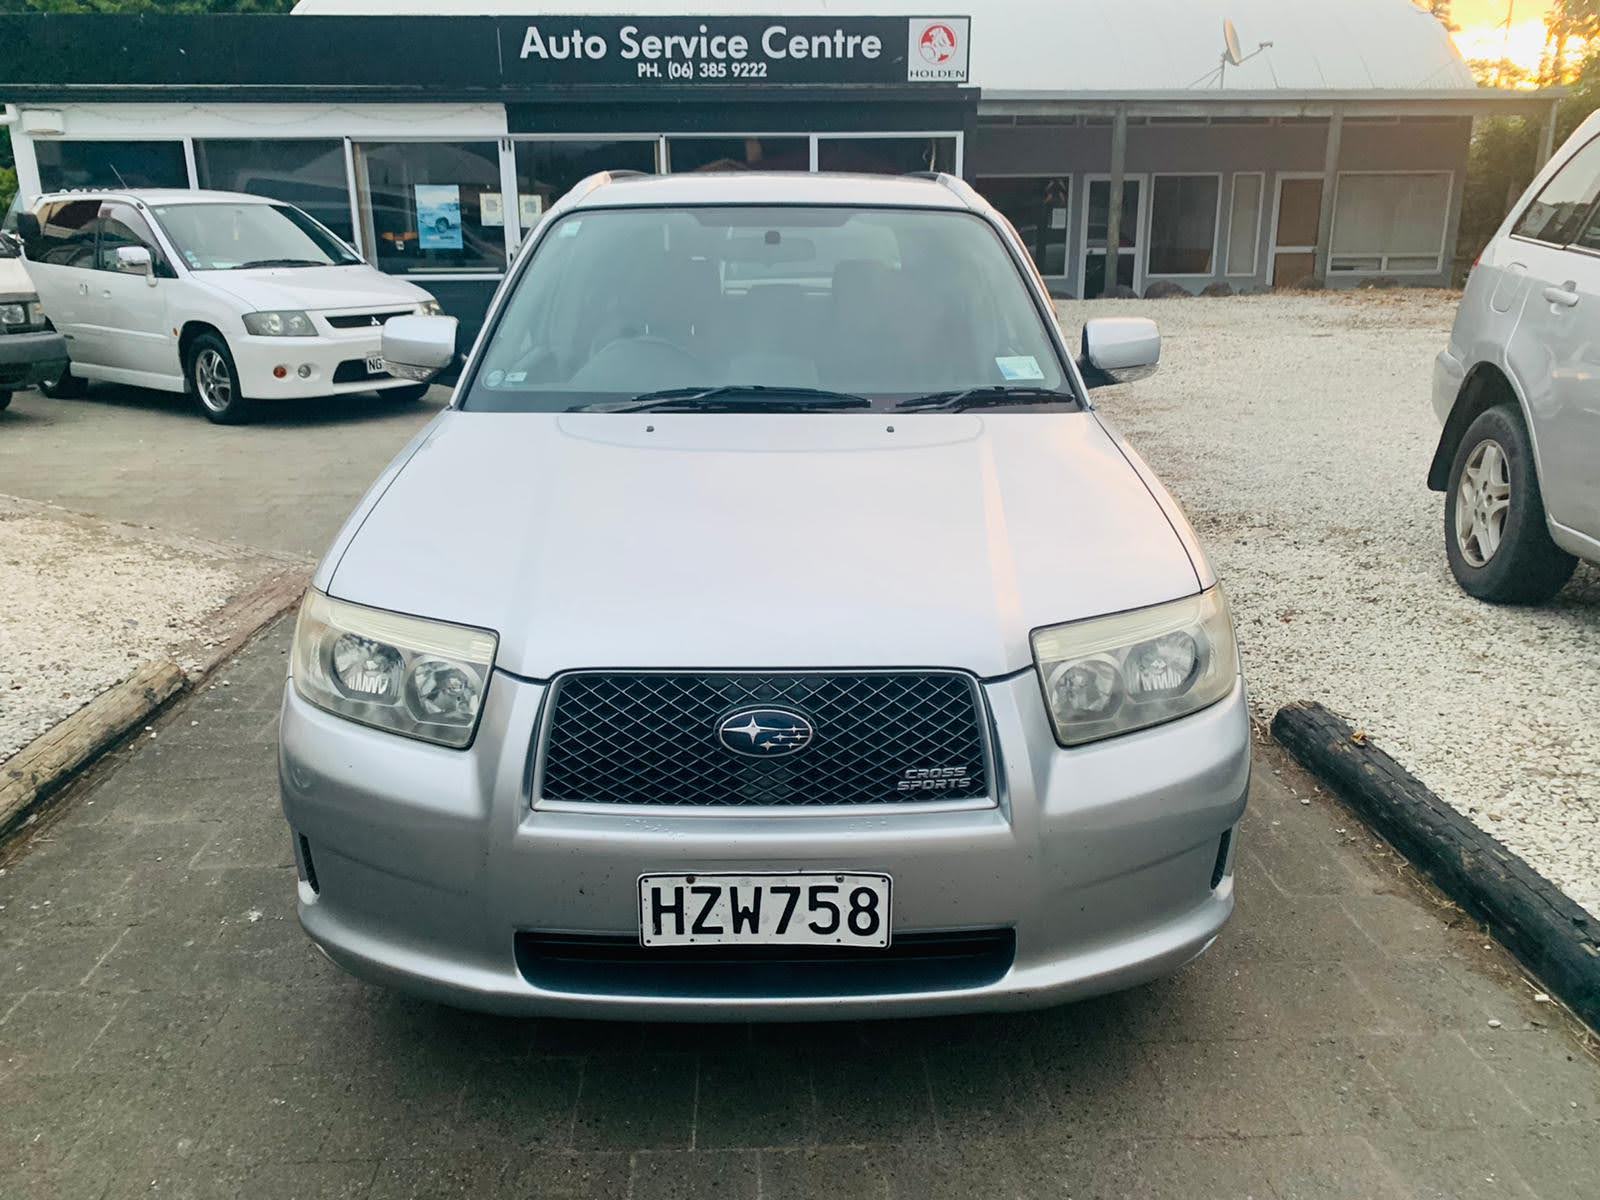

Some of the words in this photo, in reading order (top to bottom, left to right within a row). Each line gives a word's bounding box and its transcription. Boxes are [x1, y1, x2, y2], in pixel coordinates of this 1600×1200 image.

[519, 26, 607, 60] Auto
[620, 26, 749, 60] Service
[761, 26, 882, 60] Centre
[637, 63, 662, 78] PH.
[667, 62, 694, 80] (06)
[699, 63, 728, 78] 385
[731, 63, 768, 78] 9222
[909, 69, 965, 79] HOLDEN
[368, 358, 383, 371] NG
[904, 766, 967, 780] CROSS
[896, 777, 972, 791] SPORTS
[650, 885, 881, 937] HZW758
